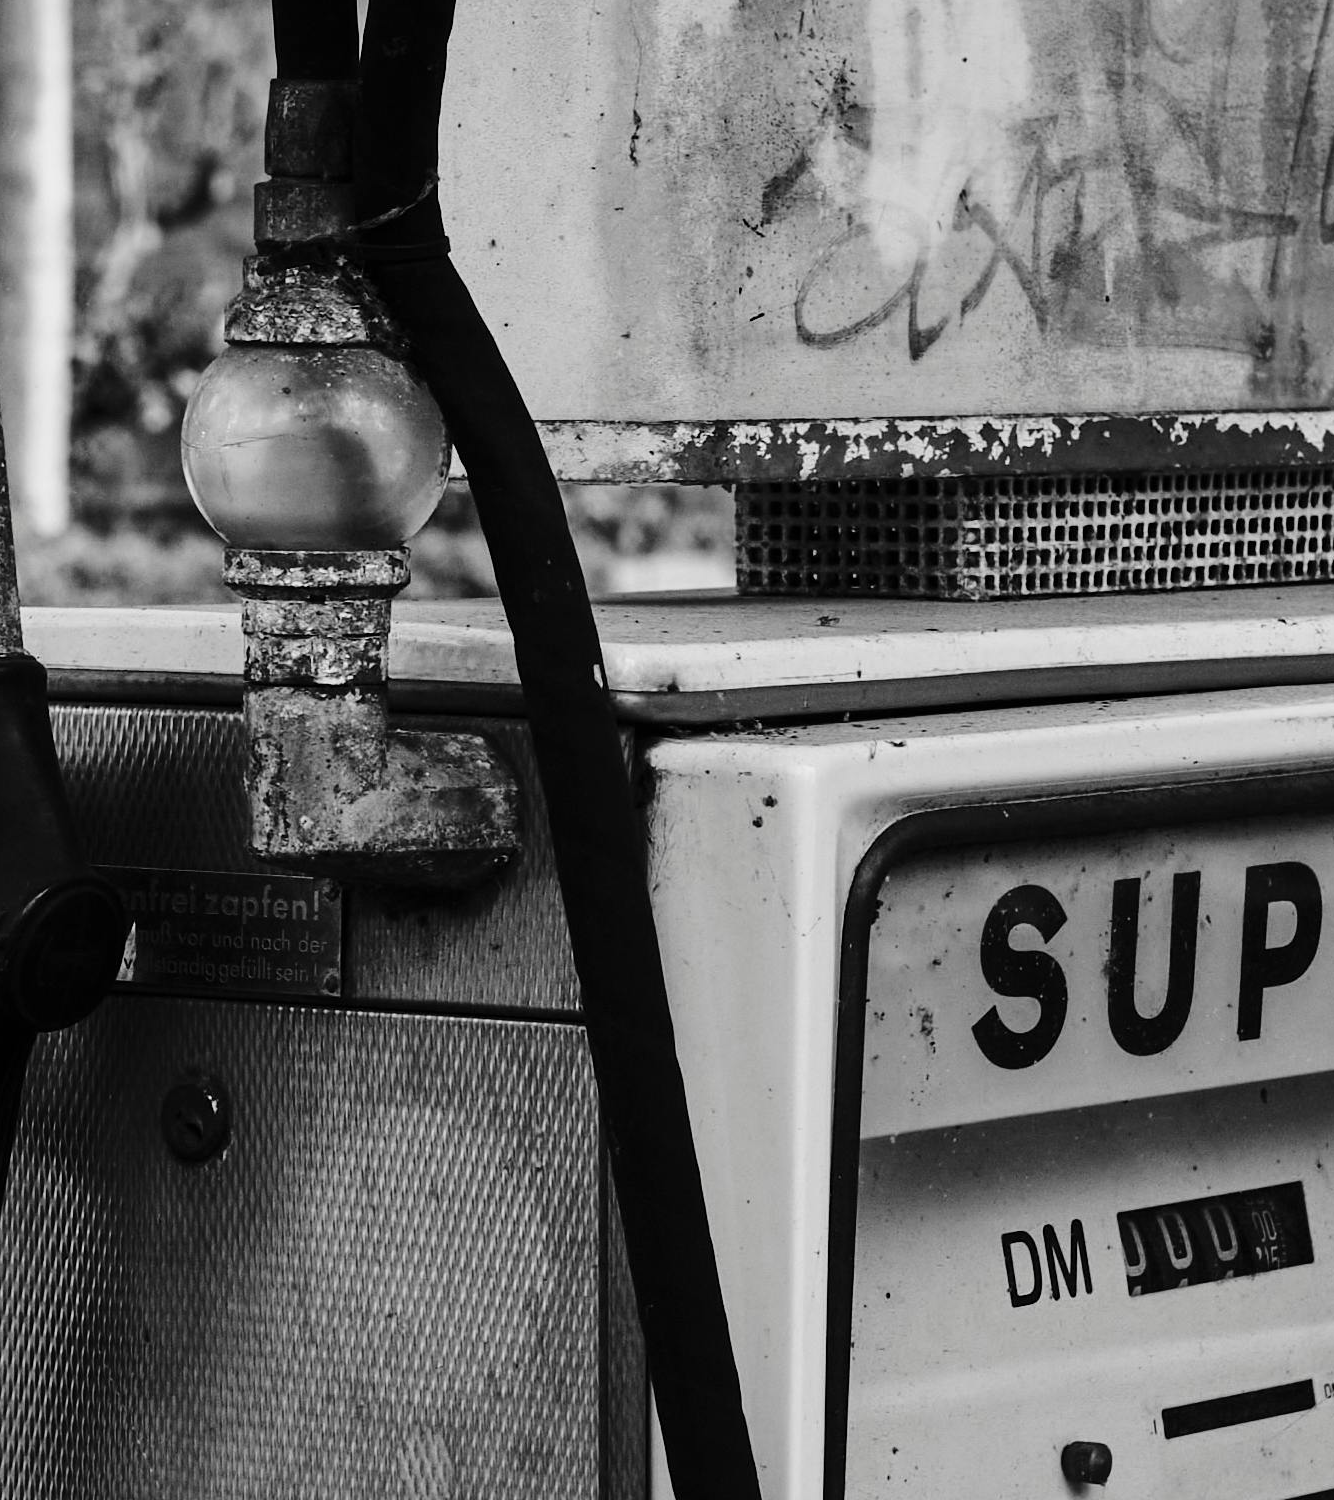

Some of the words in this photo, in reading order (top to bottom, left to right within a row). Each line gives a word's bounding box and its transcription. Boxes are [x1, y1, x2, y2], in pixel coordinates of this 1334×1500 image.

[203, 884, 320, 924] zapfen!
[178, 932, 207, 948] vor
[212, 929, 244, 949] und
[251, 928, 290, 952] nach
[298, 932, 328, 955] der
[1001, 1218, 1093, 1308] DM
